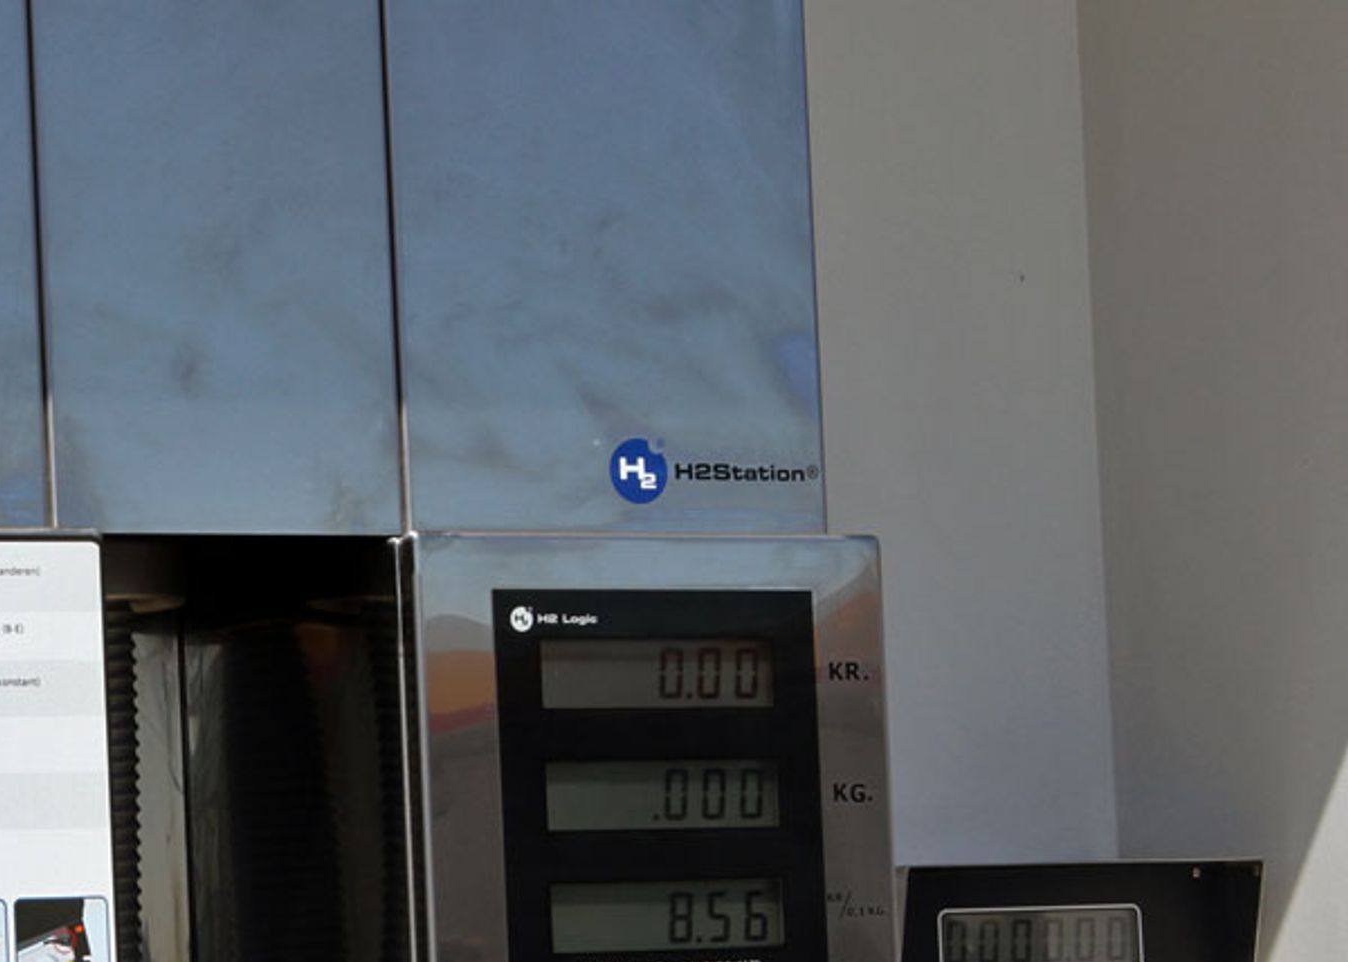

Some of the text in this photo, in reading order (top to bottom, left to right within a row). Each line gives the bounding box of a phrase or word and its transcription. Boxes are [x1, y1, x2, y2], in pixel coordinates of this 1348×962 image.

[659, 647, 758, 700] 0.00
[829, 662, 869, 681] KR.
[833, 784, 873, 803] KG.
[668, 891, 767, 944] 8.56
